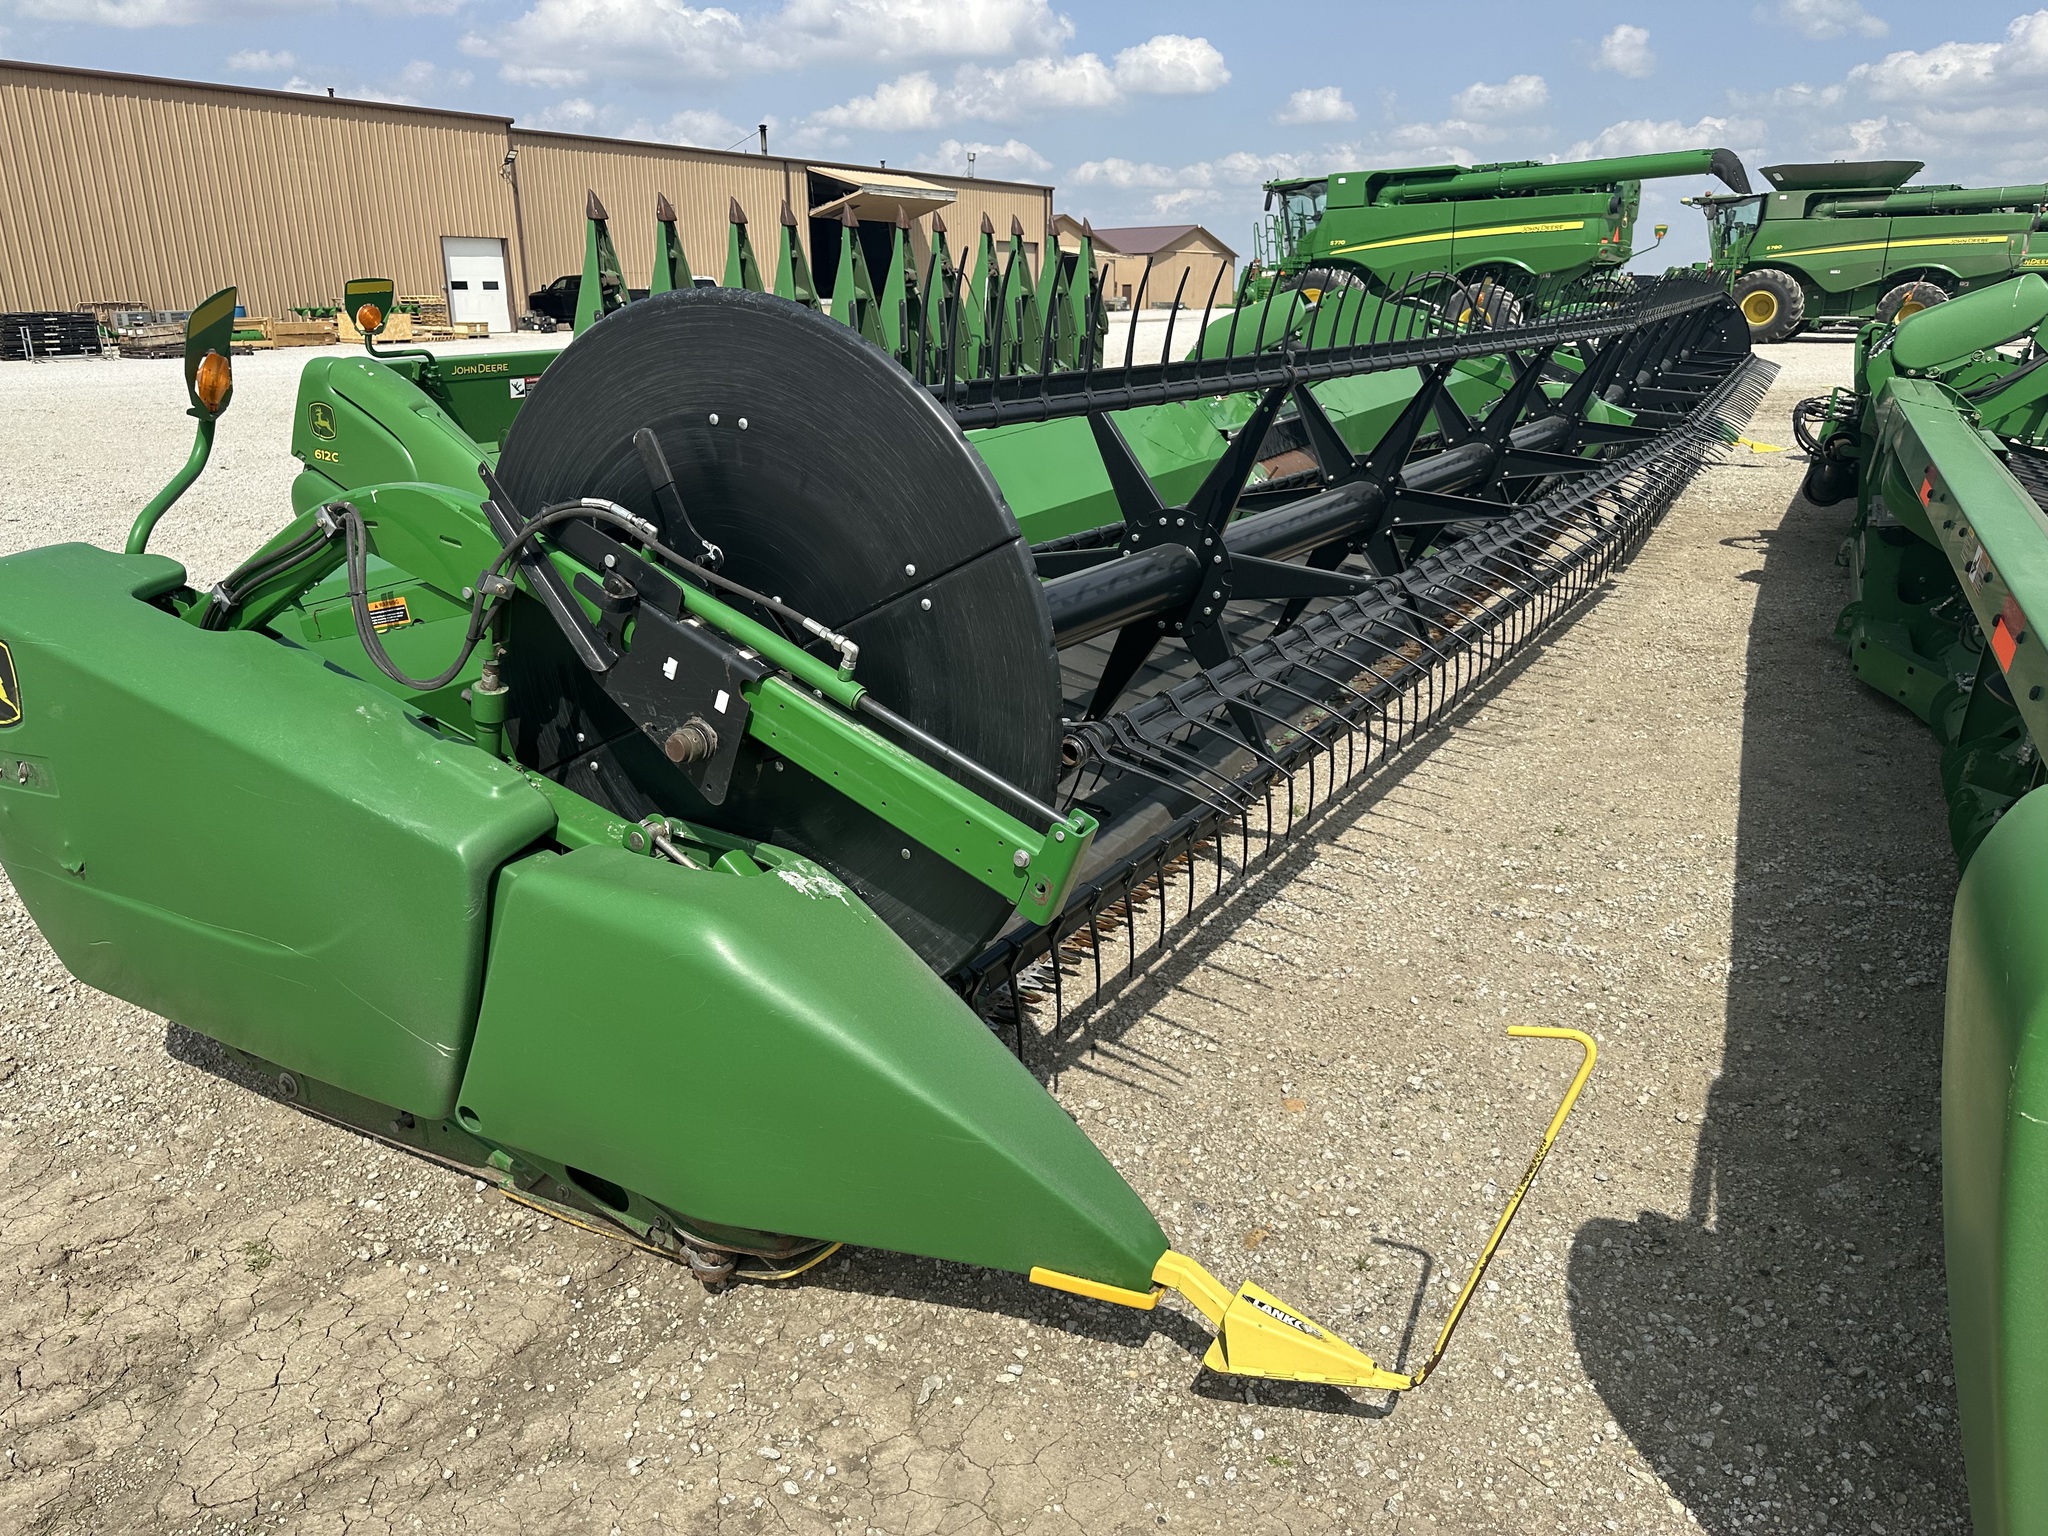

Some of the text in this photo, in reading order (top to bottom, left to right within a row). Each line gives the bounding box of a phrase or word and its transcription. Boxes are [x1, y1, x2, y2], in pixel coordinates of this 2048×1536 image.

[451, 363, 509, 376] JOHN DEERE
[314, 449, 339, 463] 612C
